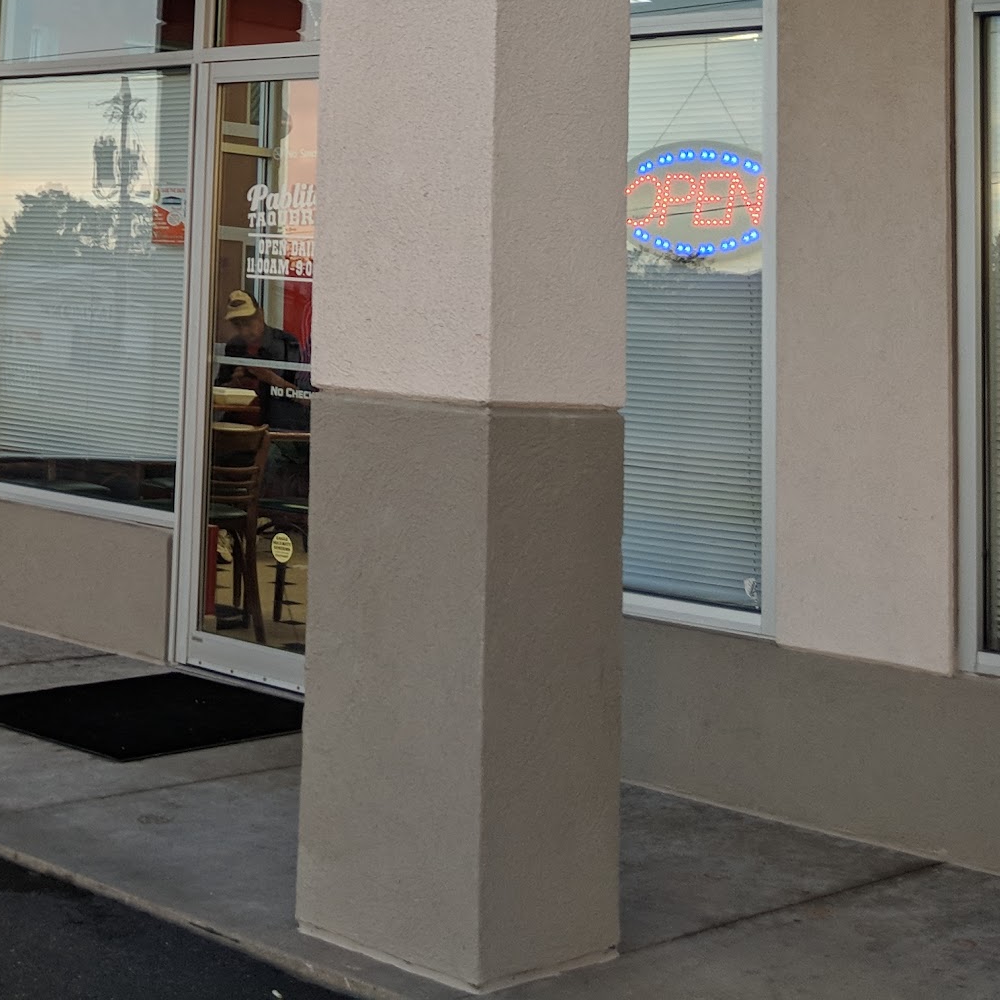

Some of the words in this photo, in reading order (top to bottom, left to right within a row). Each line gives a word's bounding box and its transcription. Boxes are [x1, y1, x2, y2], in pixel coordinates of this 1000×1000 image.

[246, 183, 316, 212] Pablit
[625, 171, 766, 227] OPEN
[248, 208, 314, 228] TAQUER
[258, 238, 287, 256] OPEN
[285, 387, 312, 400] CHEC
